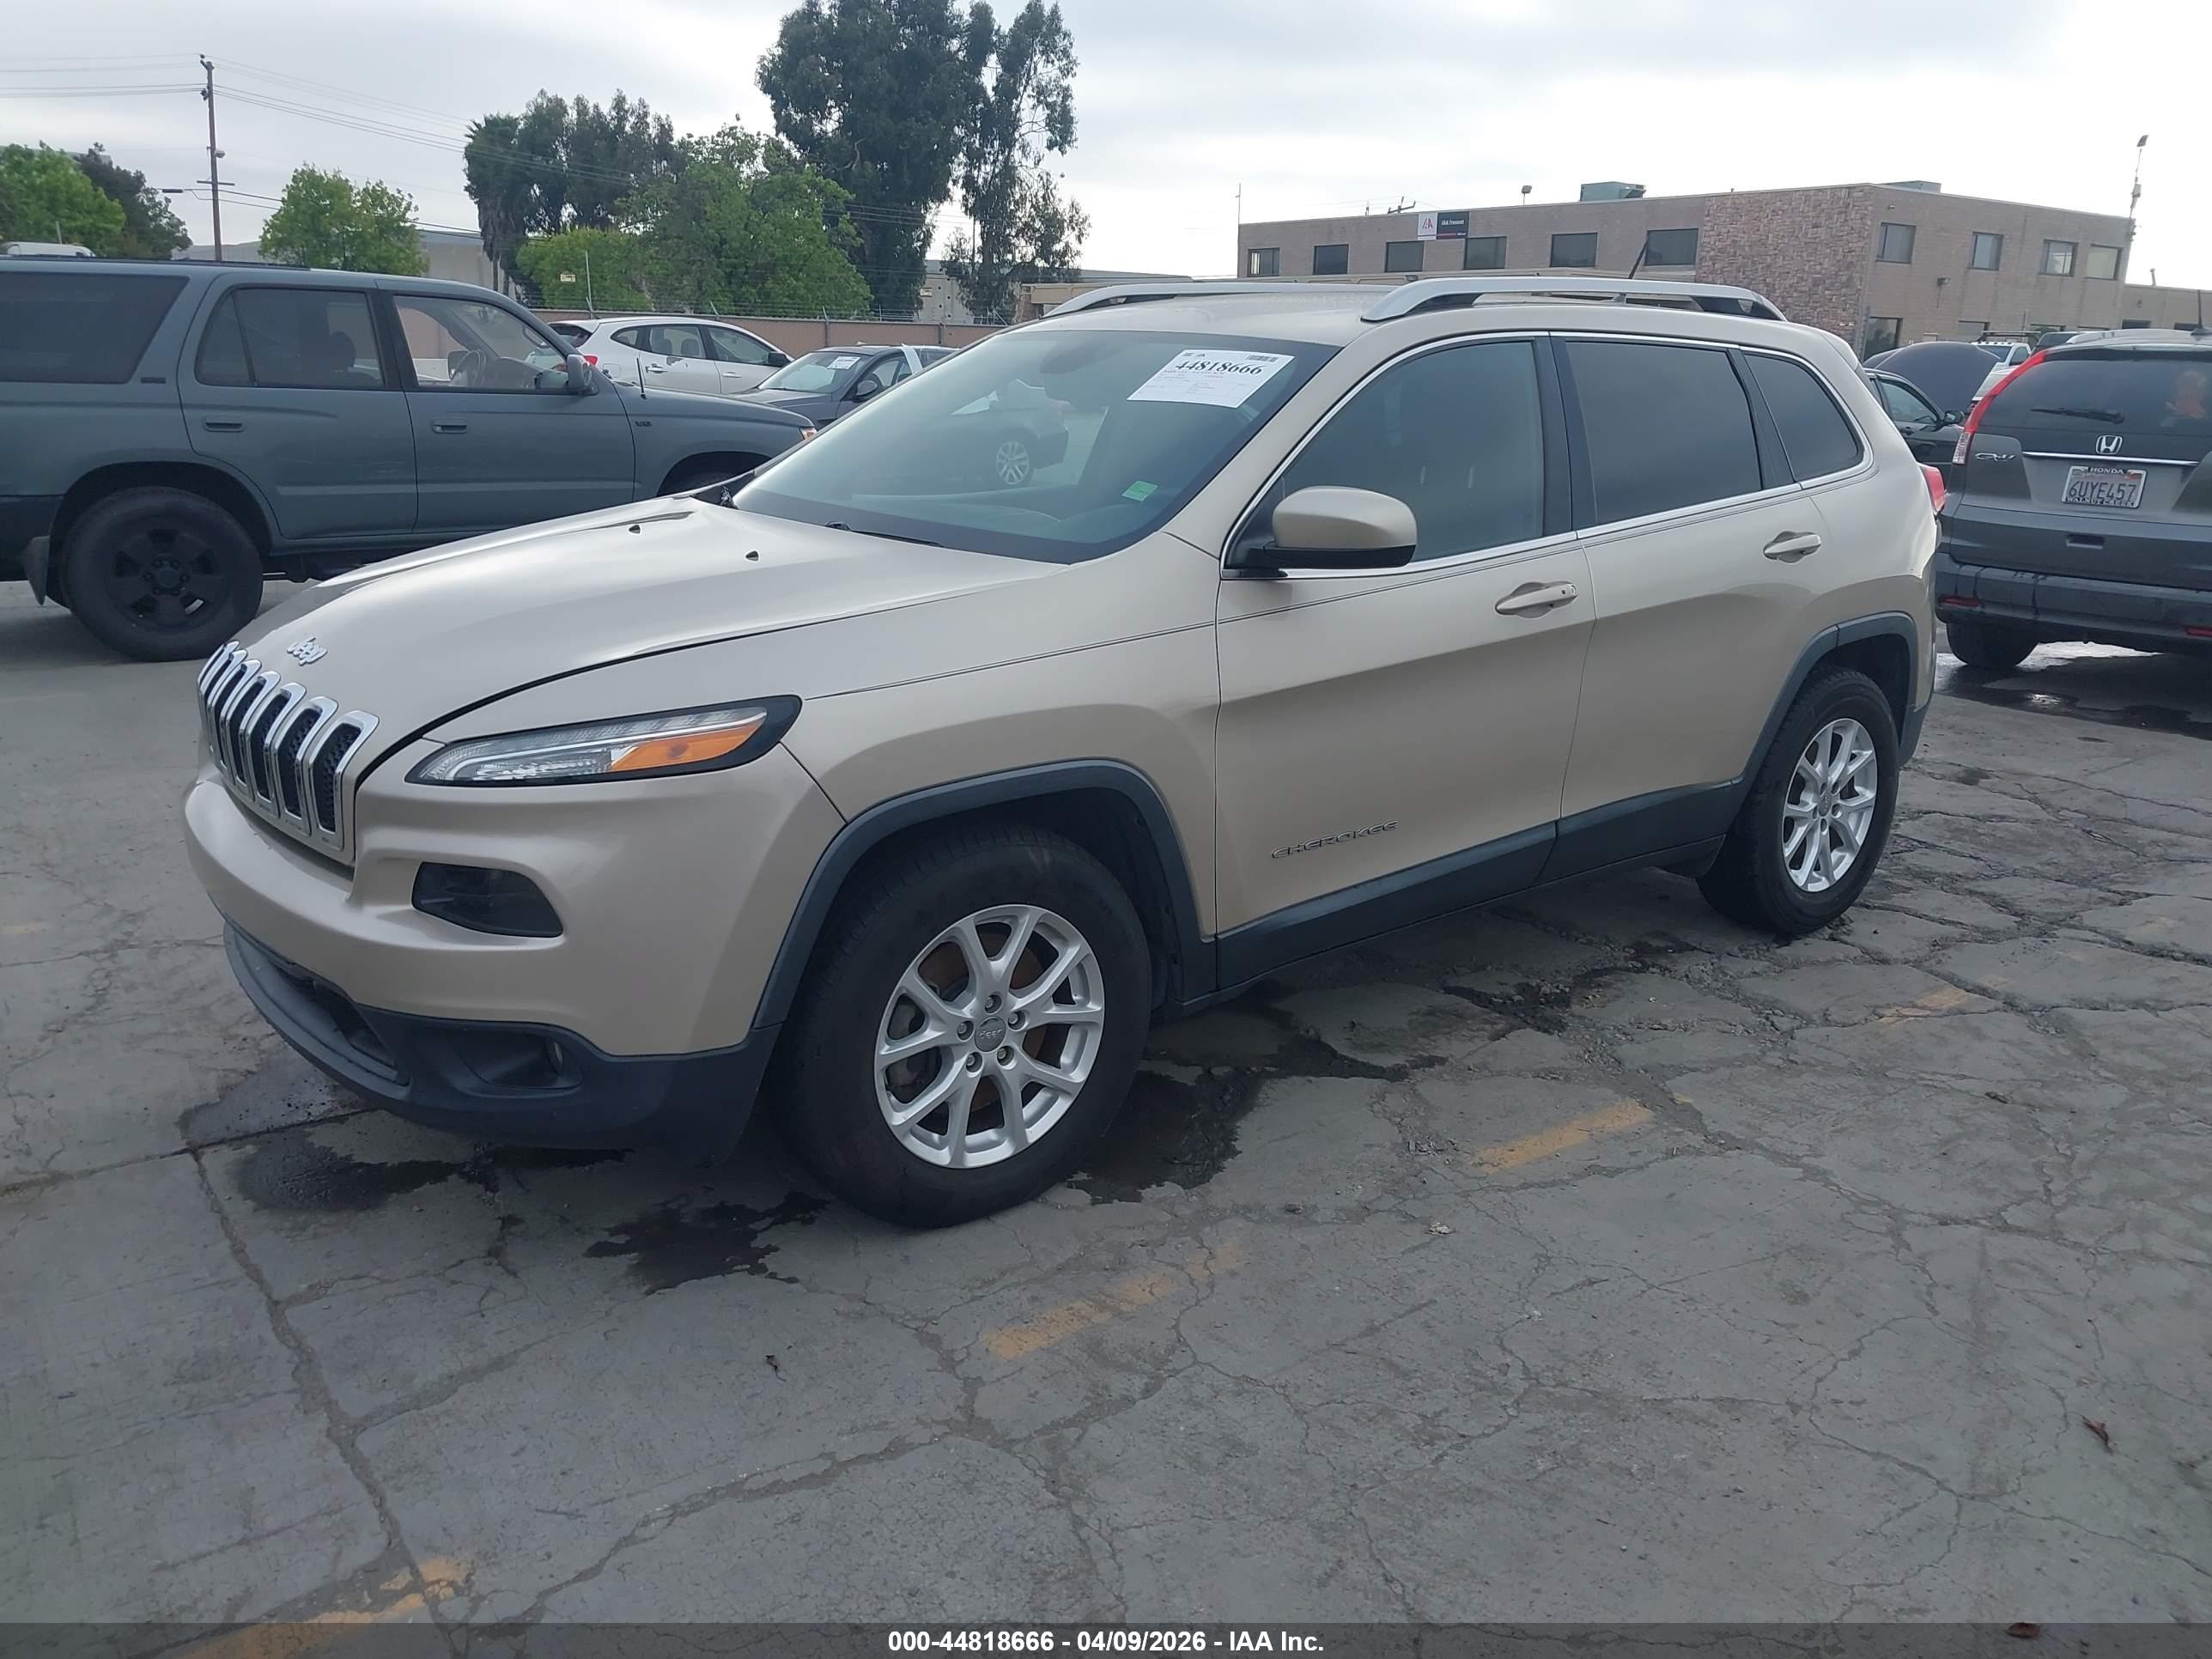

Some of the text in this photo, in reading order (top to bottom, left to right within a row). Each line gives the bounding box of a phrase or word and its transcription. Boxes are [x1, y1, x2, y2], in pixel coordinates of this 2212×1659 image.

[1175, 360, 1267, 375] 44818666
[2066, 496, 2103, 506] WALNUT
[2068, 480, 2137, 501] 6UYE457
[286, 636, 328, 666] Jeep
[1272, 820, 1398, 859] CHEROKEE
